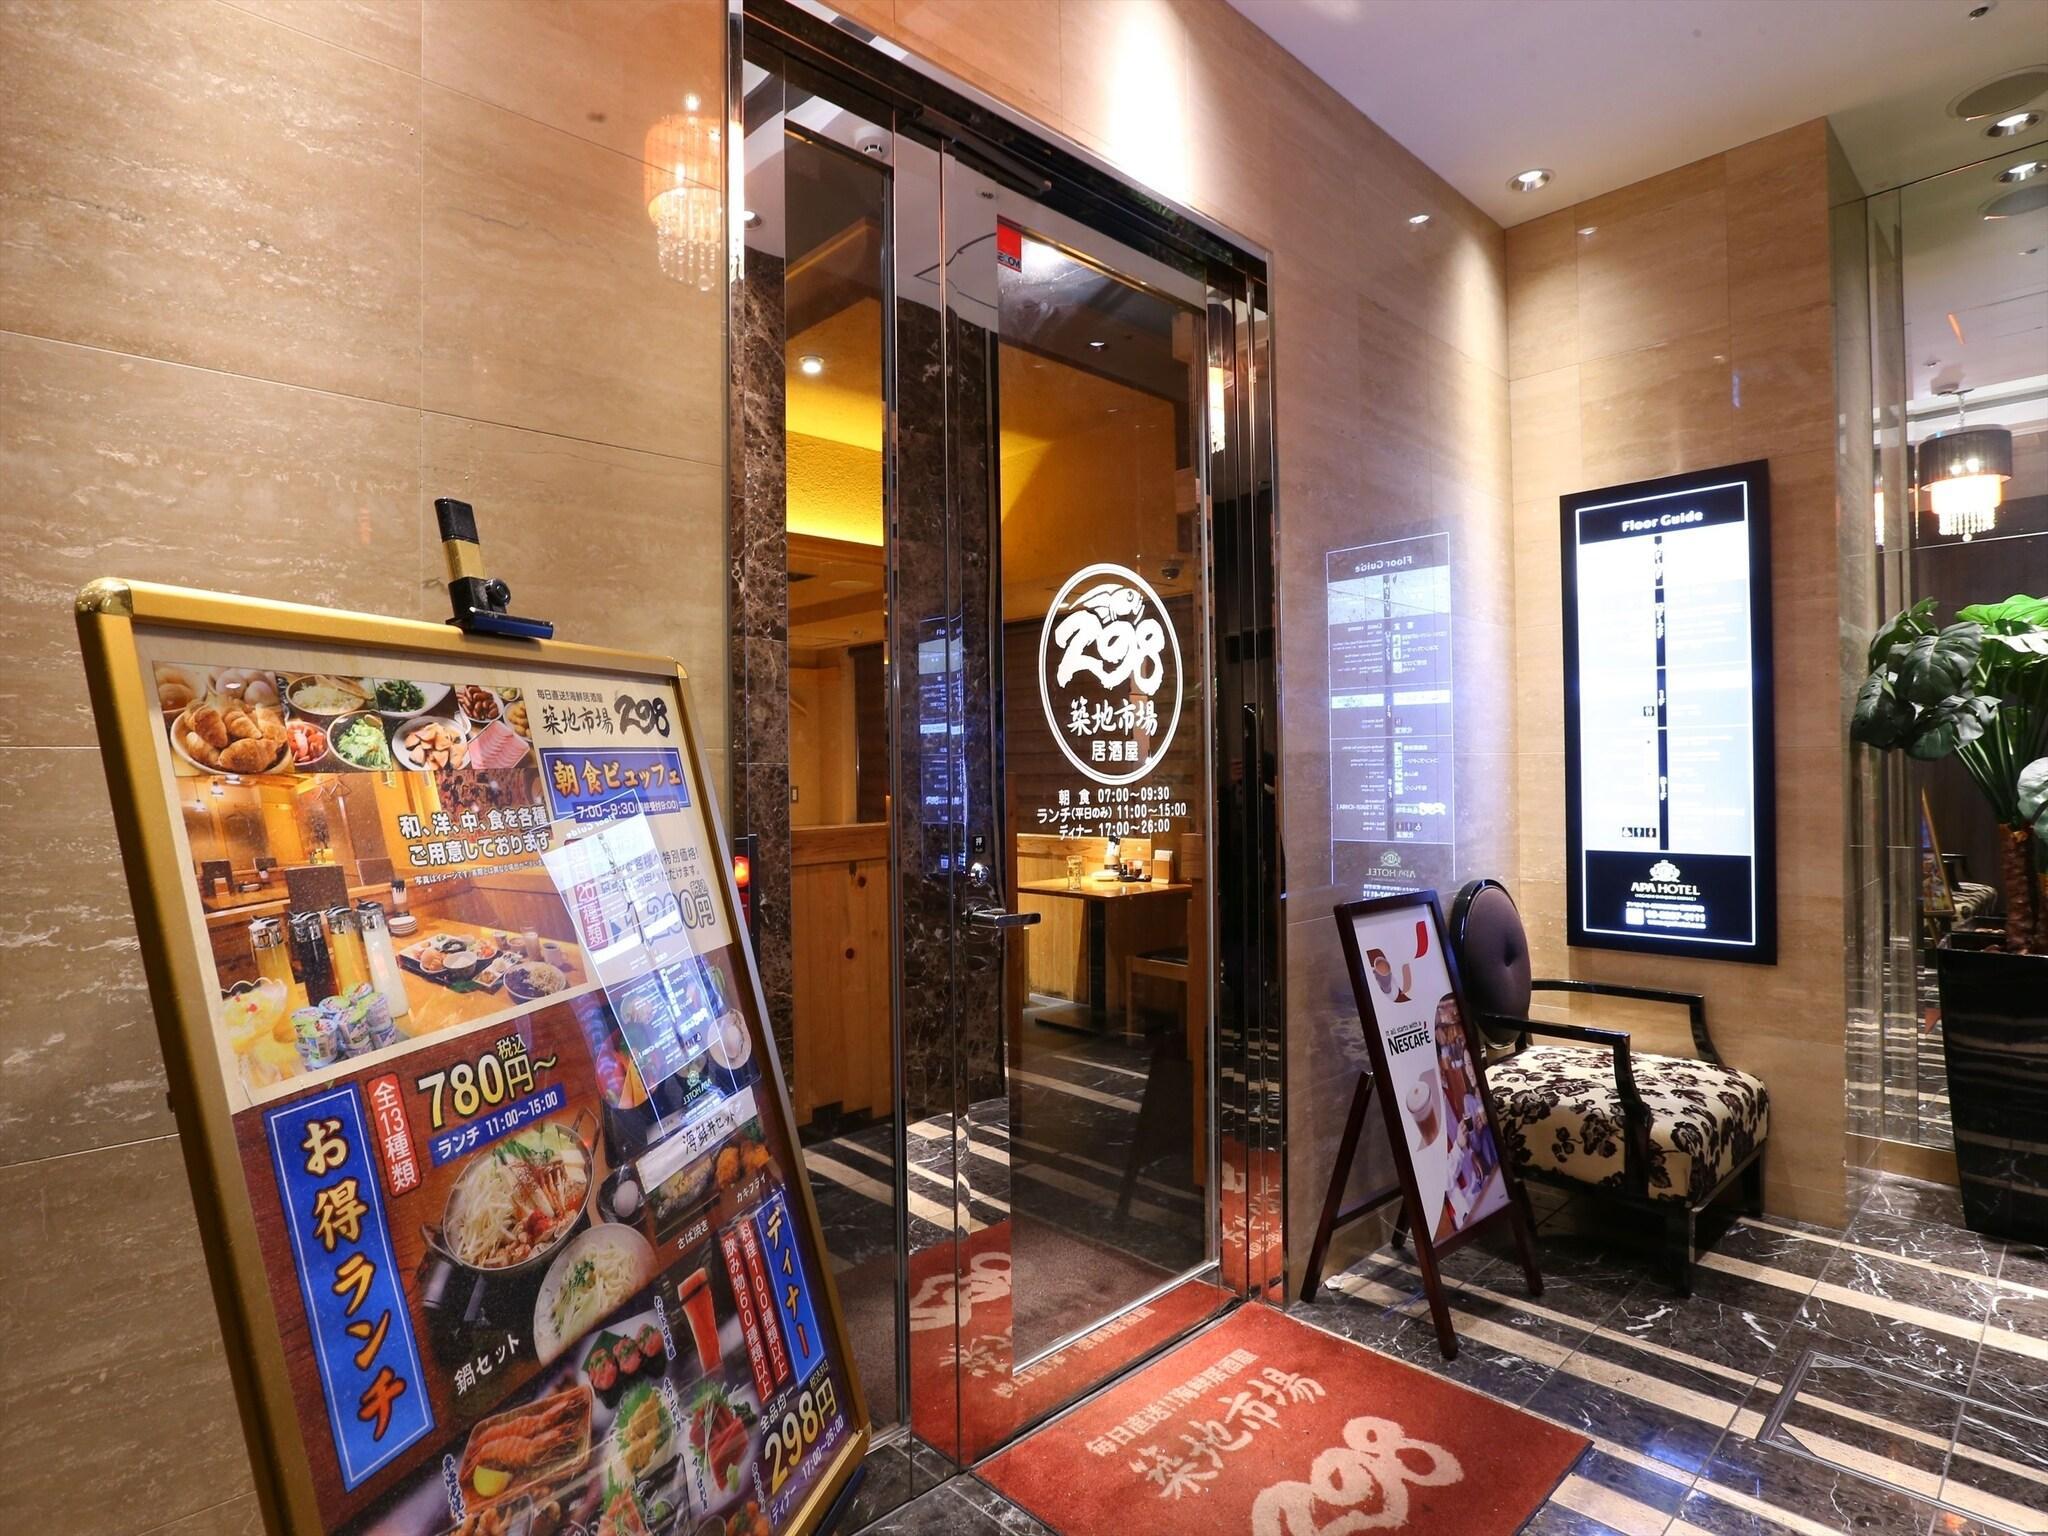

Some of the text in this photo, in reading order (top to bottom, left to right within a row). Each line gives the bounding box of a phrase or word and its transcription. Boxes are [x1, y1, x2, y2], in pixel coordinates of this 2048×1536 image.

[1622, 510, 1703, 532] Floor Guide
[1055, 610, 1165, 696] 298
[542, 694, 670, 738] 築地市場 298
[1067, 696, 1158, 736] 築地市場
[1092, 741, 1139, 761] 居酒屋
[553, 758, 682, 799] 朝食ビュッフェ
[1097, 786, 1170, 803] 07:00～09:30
[398, 805, 549, 839] 和、洋、中、食を各種
[1036, 803, 1187, 824] ランチ(平日のみ) 11:00～15:00
[1059, 818, 1170, 840] ディナー 17:00～26:00
[409, 830, 550, 866] ご用意しております
[1631, 882, 1701, 896] APA HOTEL
[496, 1033, 527, 1059] 税込
[373, 1080, 417, 1192] 全13種類
[438, 1091, 558, 1159] ランチ 11:00～15:00
[736, 1173, 767, 1203] カキフライ
[677, 1220, 709, 1250] さば焼き
[301, 1117, 407, 1442] お得ランチ
[765, 1205, 811, 1359] ディナー
[454, 1333, 520, 1396] 鍋セット
[760, 1386, 794, 1435] 全品均一
[765, 1377, 837, 1496] 298円
[1129, 1367, 1326, 1500] 築地市場
[771, 1415, 844, 1525] ディナー 17:00～26:00
[1252, 1416, 1464, 1536] 298
